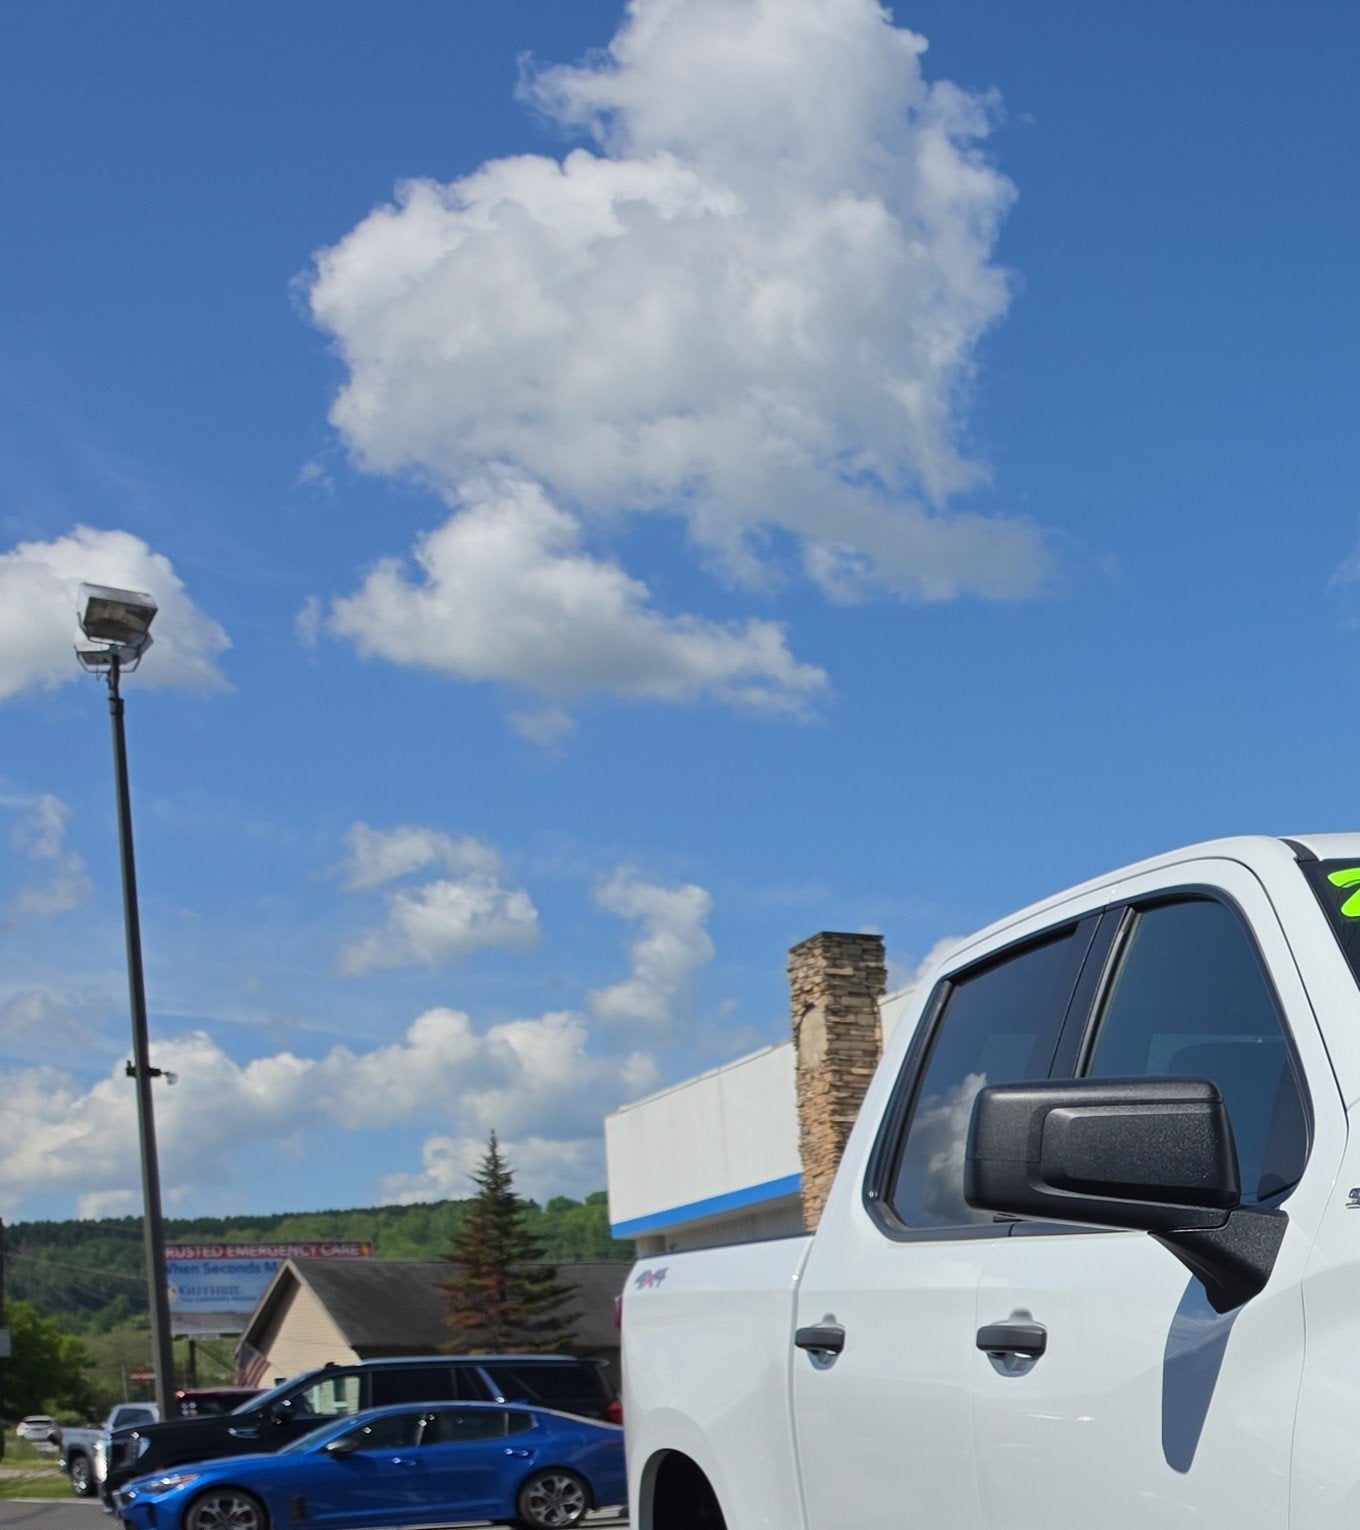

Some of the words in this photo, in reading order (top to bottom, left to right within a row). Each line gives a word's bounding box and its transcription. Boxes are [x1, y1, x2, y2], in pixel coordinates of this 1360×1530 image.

[165, 1245, 225, 1259] RUSTED
[226, 1244, 317, 1258] EMERGENCY
[320, 1242, 361, 1257] CARE
